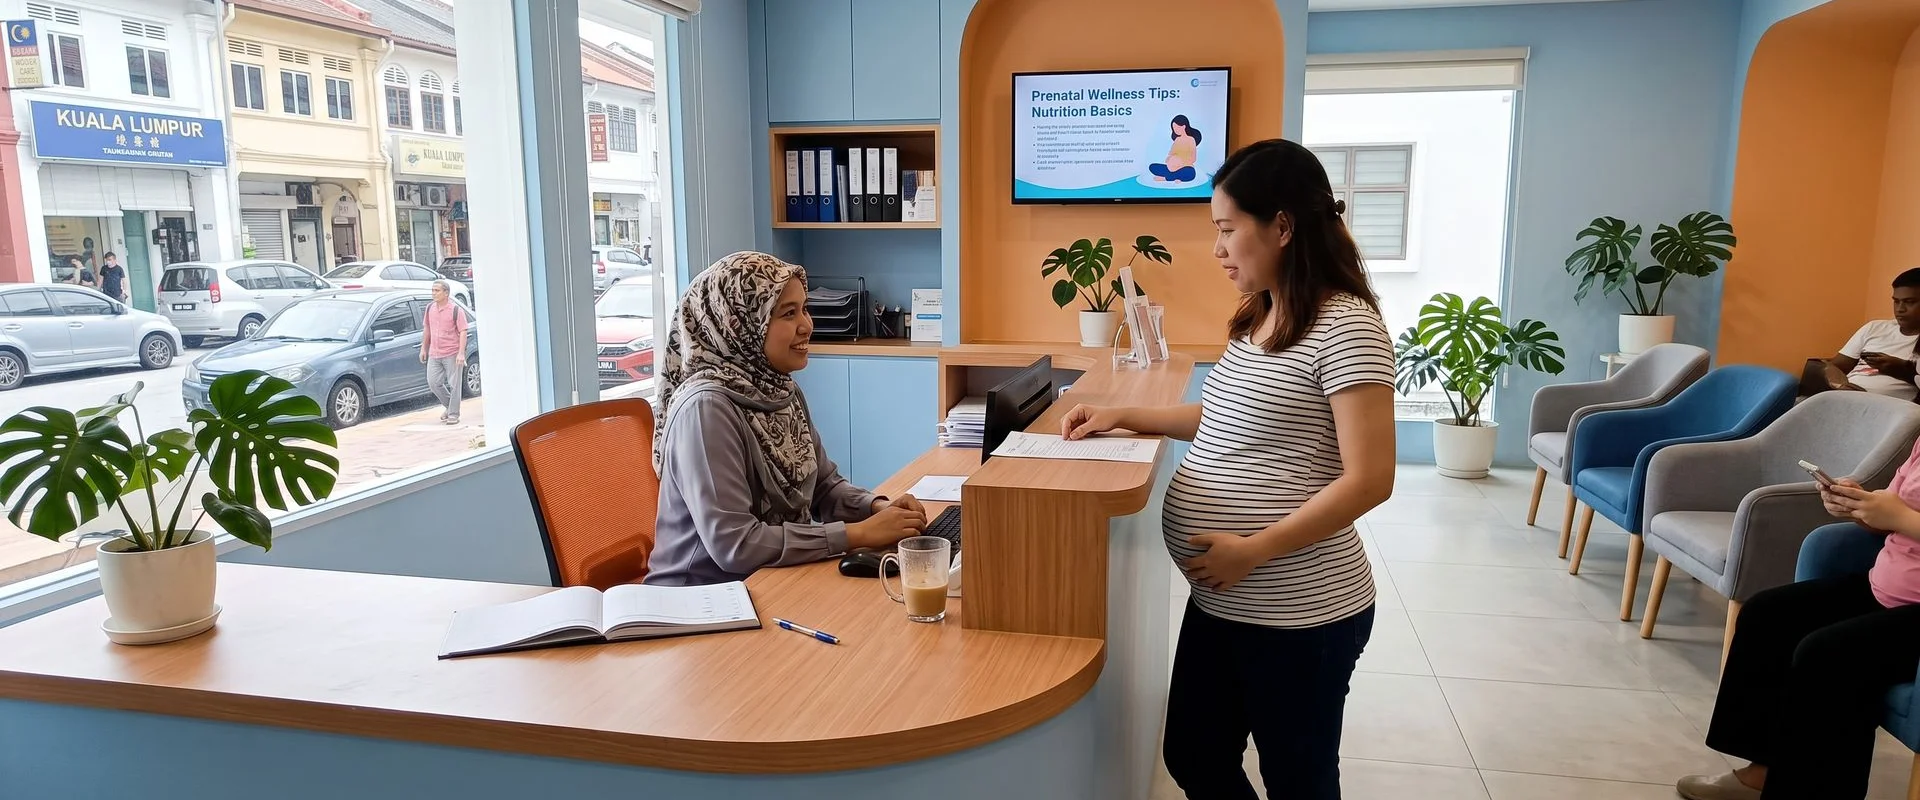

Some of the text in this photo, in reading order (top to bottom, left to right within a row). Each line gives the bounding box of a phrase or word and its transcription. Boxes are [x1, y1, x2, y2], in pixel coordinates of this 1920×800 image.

[1031, 86, 1181, 102] Prenatal Wellness Tips:
[1031, 104, 1133, 118] Nutrition Basics
[56, 108, 204, 138] KUALA LUMPUR
[423, 148, 444, 161] KUALA
